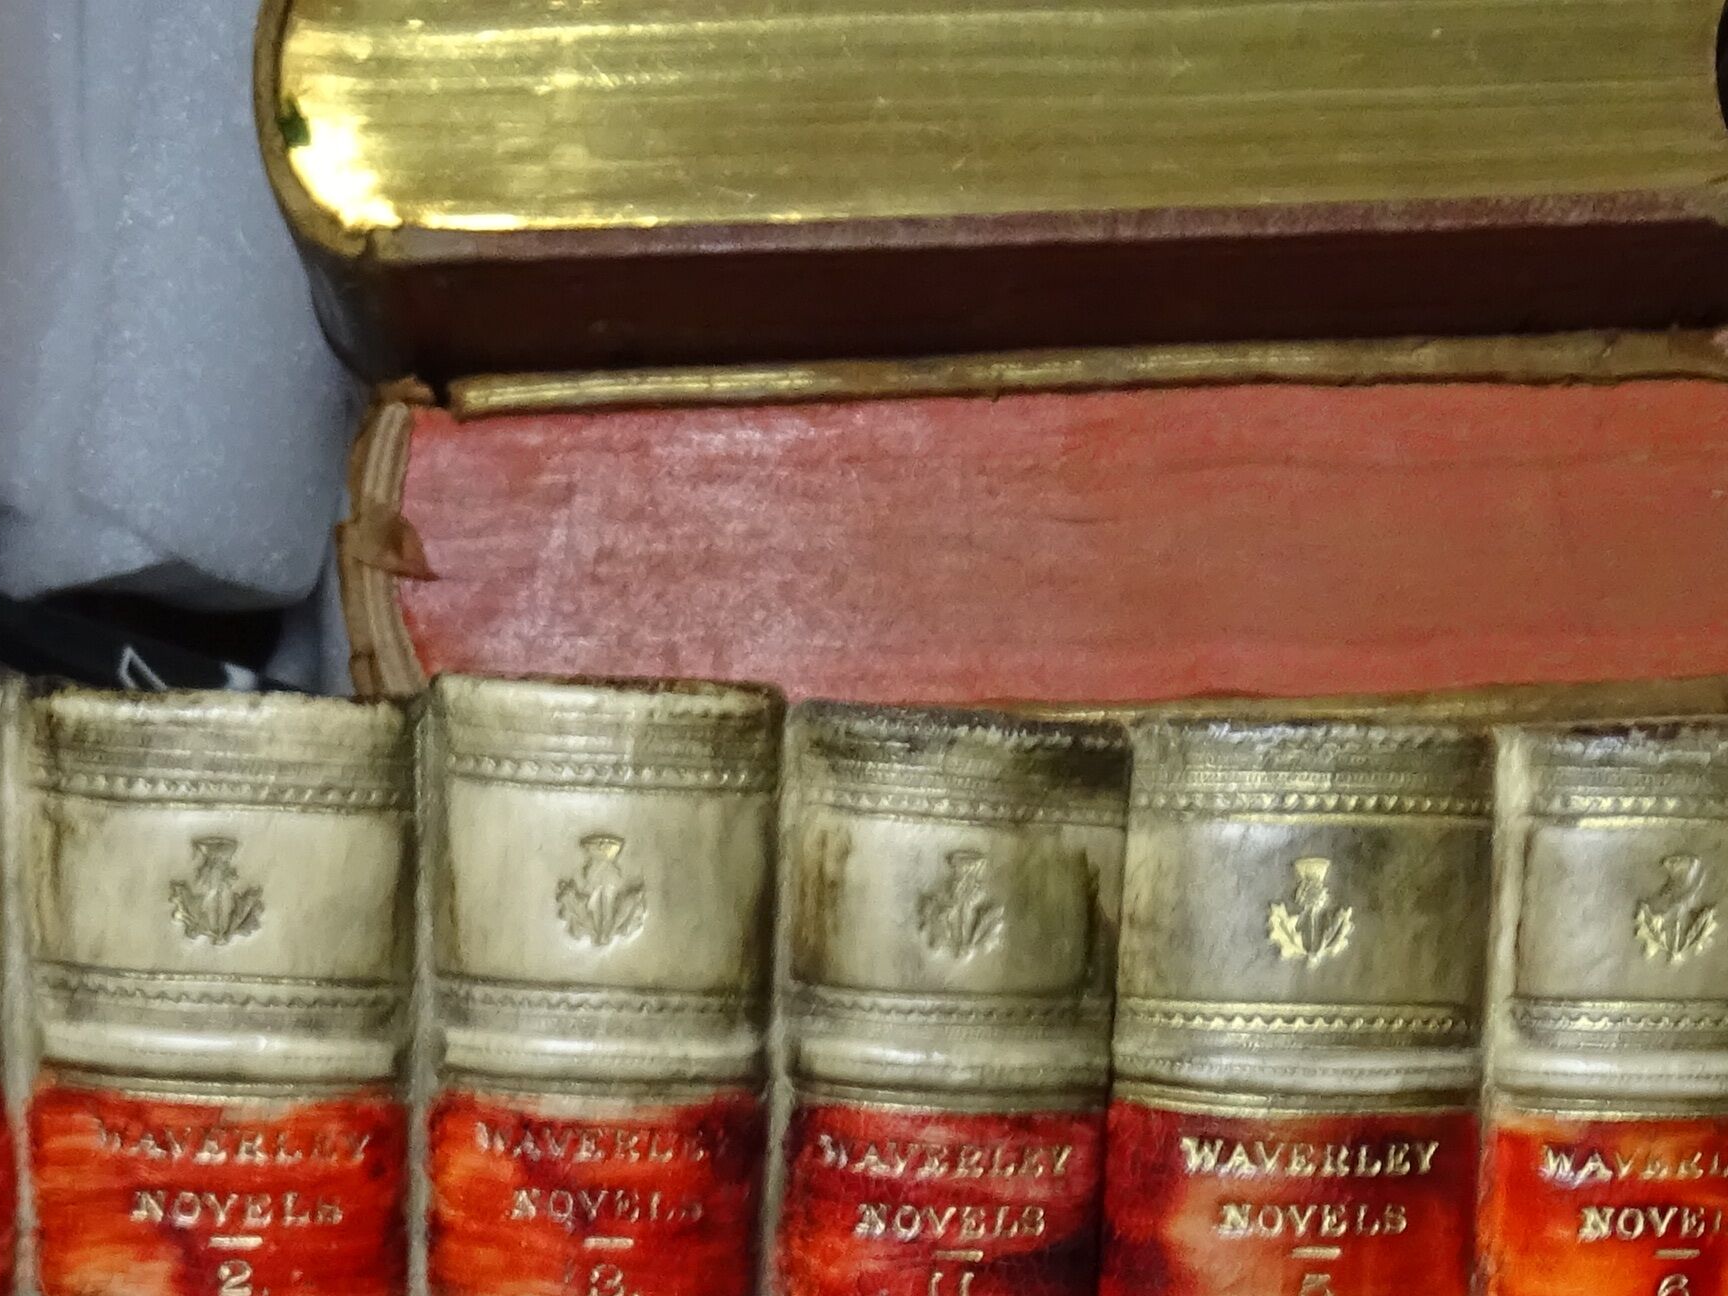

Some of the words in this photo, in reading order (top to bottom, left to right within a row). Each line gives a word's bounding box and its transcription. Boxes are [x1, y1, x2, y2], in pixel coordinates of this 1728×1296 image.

[818, 1133, 1072, 1181] WAVERLEY
[1180, 1135, 1439, 1179] WAVERLEY
[854, 1203, 1046, 1242] NOVELS
[1218, 1203, 1407, 1240] NOVELS
